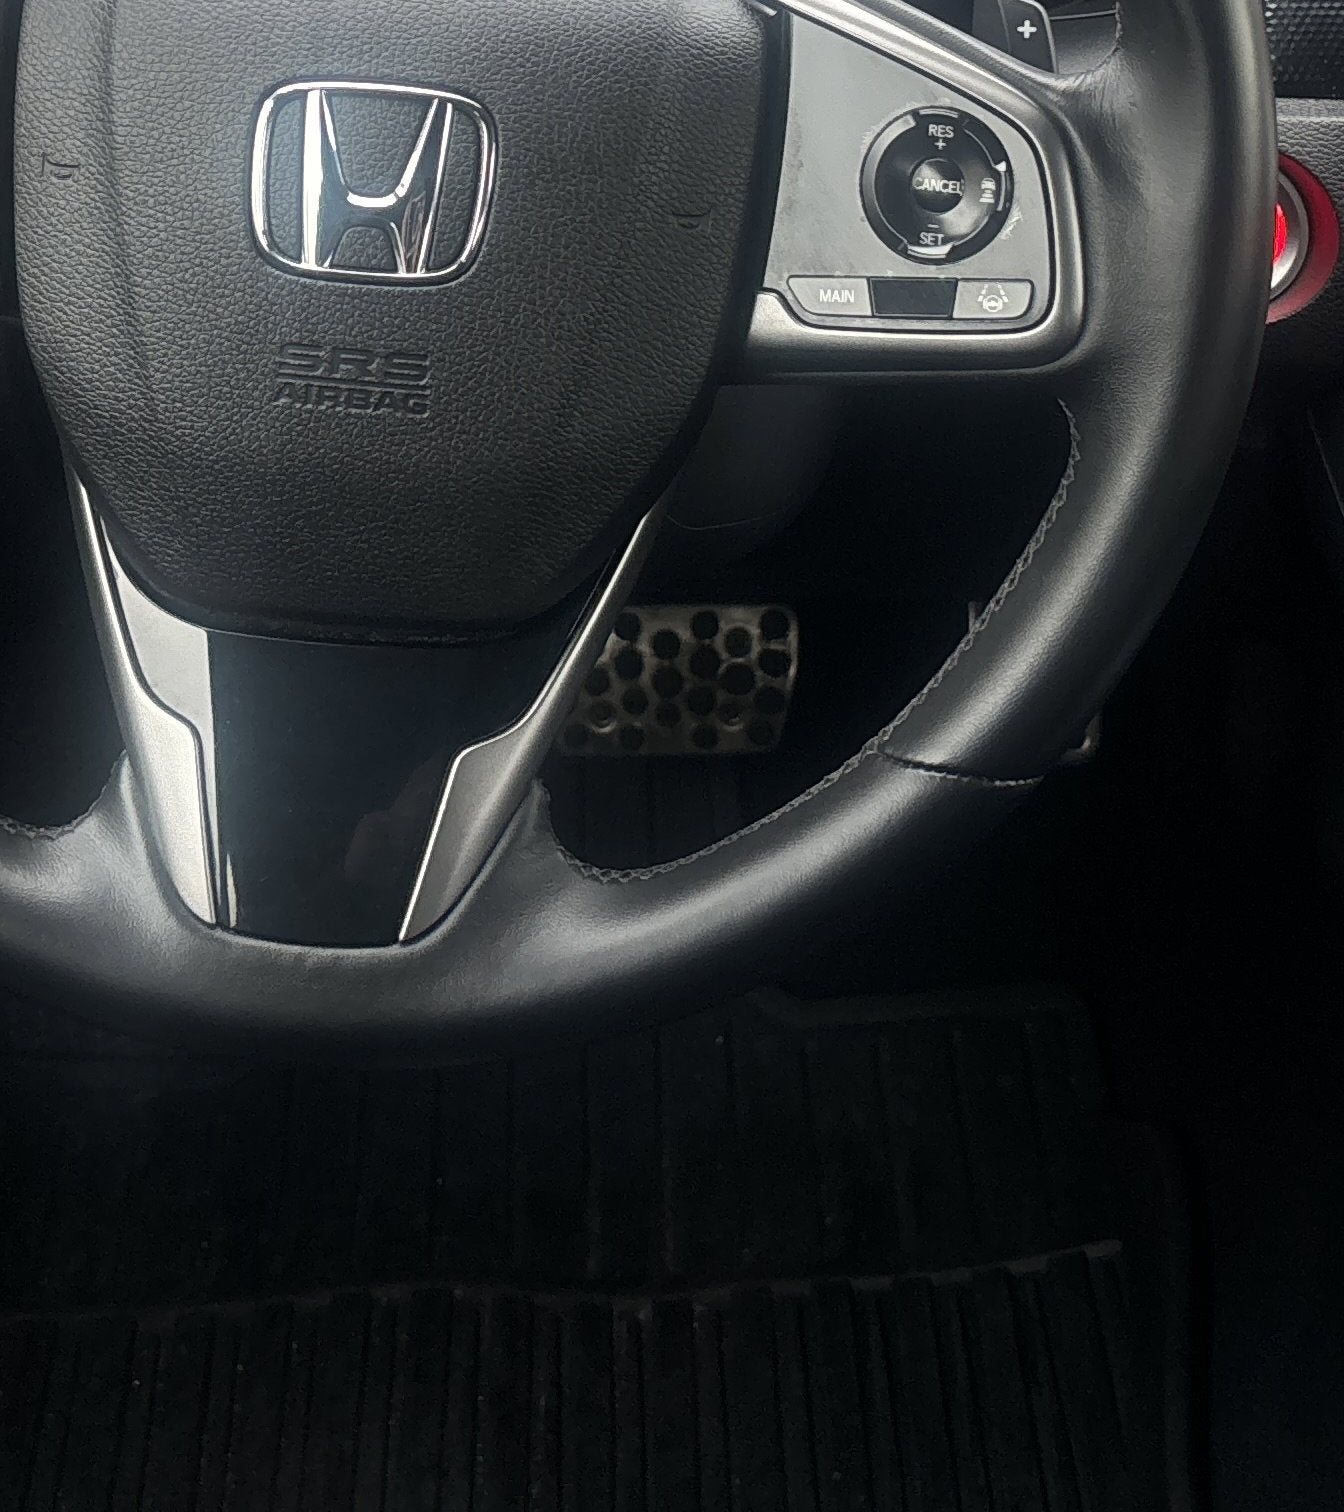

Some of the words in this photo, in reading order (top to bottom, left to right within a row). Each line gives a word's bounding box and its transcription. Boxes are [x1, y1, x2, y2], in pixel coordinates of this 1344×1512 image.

[927, 123, 954, 138] RES
[912, 176, 964, 196] CANCEL
[919, 231, 943, 246] SET
[819, 289, 855, 304] MAIN
[275, 343, 432, 386] SRS
[272, 386, 432, 419] AIRBAG
